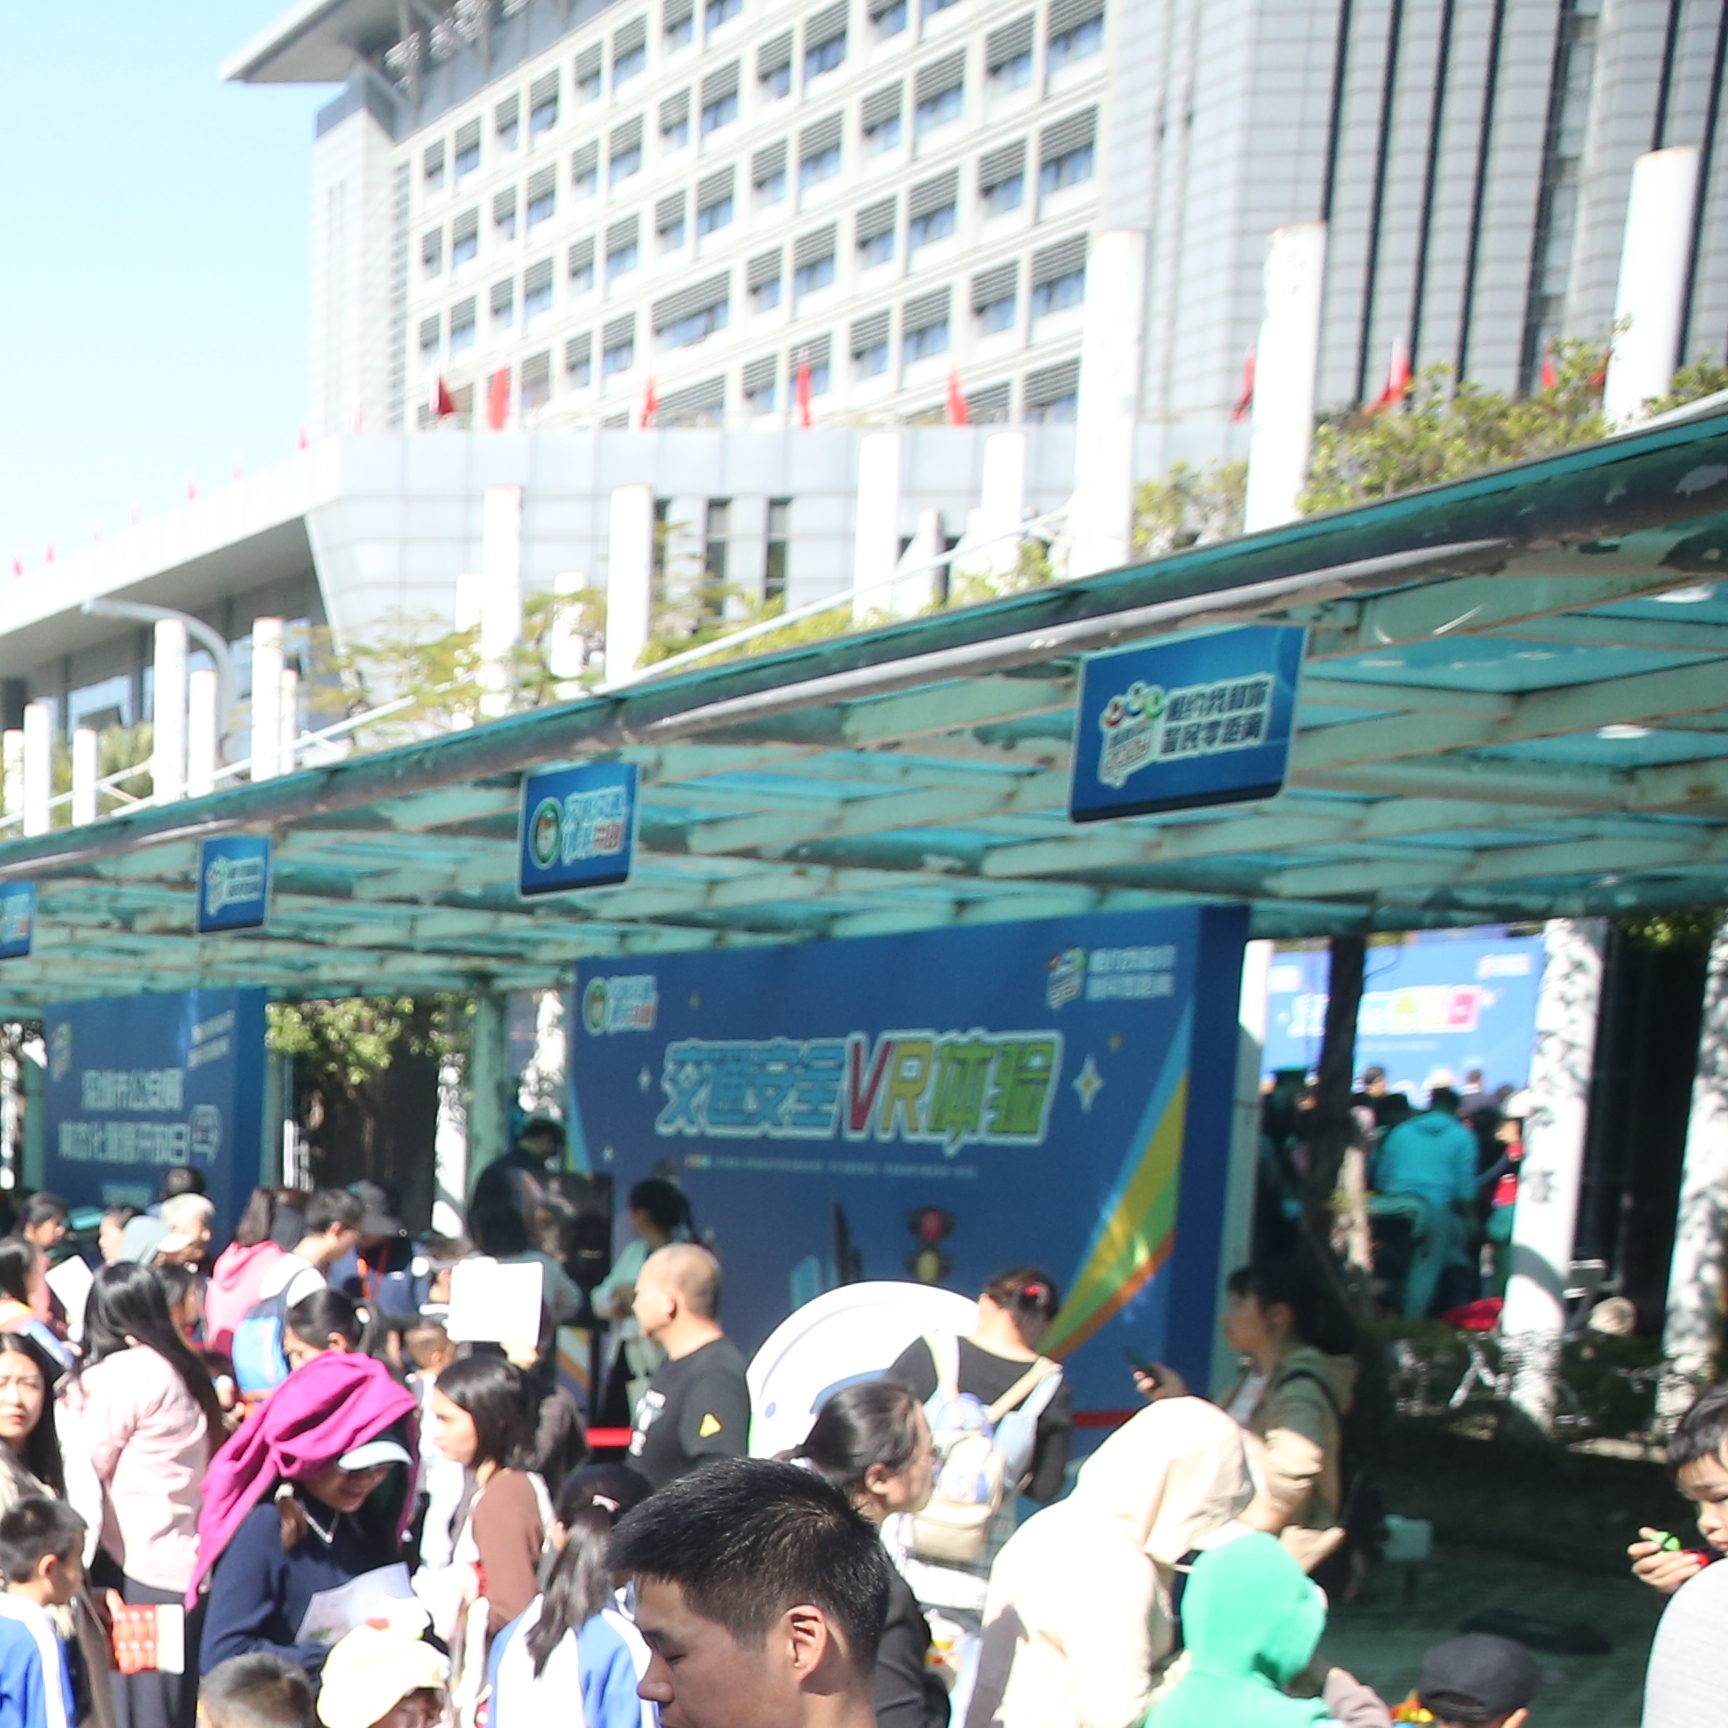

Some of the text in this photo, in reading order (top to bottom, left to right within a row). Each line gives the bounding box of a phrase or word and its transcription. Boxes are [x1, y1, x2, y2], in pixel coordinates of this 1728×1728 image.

[658, 1030, 1060, 1154] 交通安全VR体验
